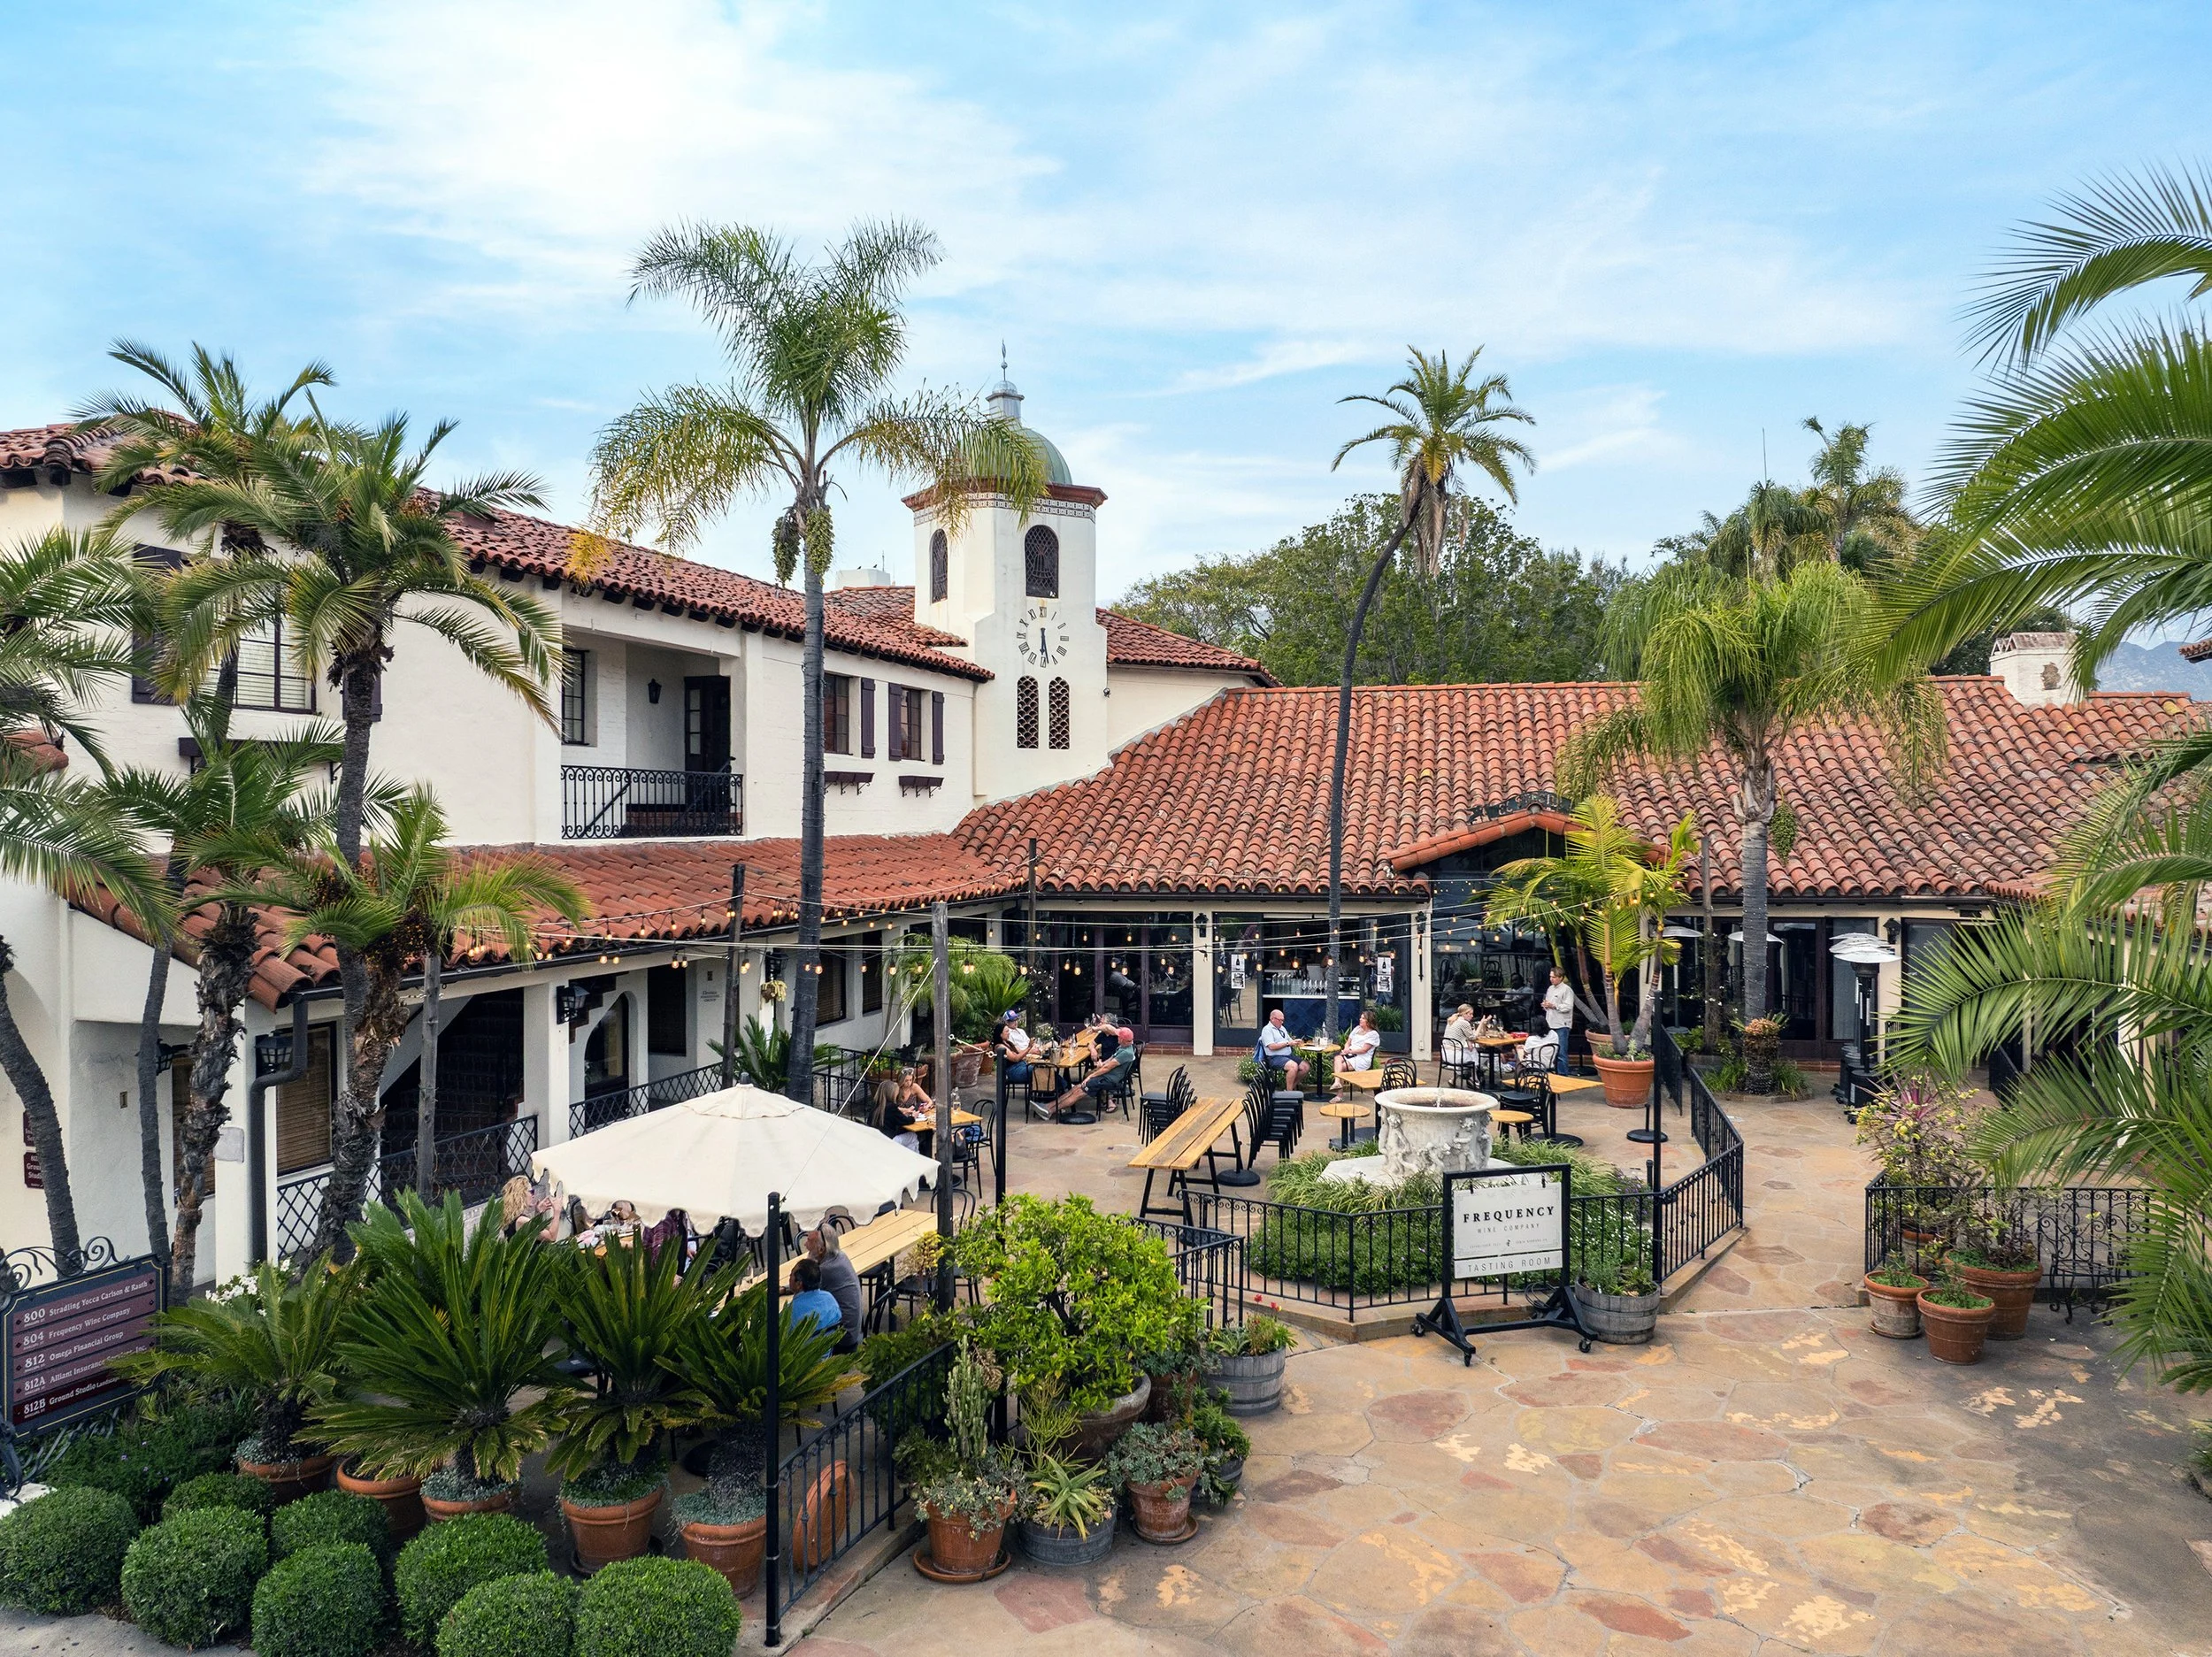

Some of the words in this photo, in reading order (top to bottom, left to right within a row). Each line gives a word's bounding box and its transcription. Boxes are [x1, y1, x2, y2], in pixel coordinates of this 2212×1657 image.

[1463, 1206, 1555, 1223] FREQUENCY
[1468, 1260, 1514, 1272] TASTING
[1521, 1256, 1551, 1267] ROOM
[24, 1308, 45, 1323] 800
[50, 1300, 81, 1316] Stradling
[81, 1295, 100, 1308] Yocca
[101, 1289, 123, 1300] Carlson
[131, 1281, 148, 1292] Rauth
[23, 1331, 44, 1345] 804
[49, 1323, 82, 1339] Frequency
[84, 1316, 101, 1327] Wine
[103, 1308, 131, 1322] Company
[25, 1354, 45, 1368] 812
[50, 1348, 72, 1361] Omega
[73, 1337, 103, 1353] Financial
[104, 1331, 124, 1342] Group
[25, 1377, 45, 1391] 812A
[50, 1369, 73, 1383] Alliant
[24, 1398, 46, 1414] 812B
[50, 1390, 74, 1405] Ground
[75, 1384, 96, 1395] Studio
